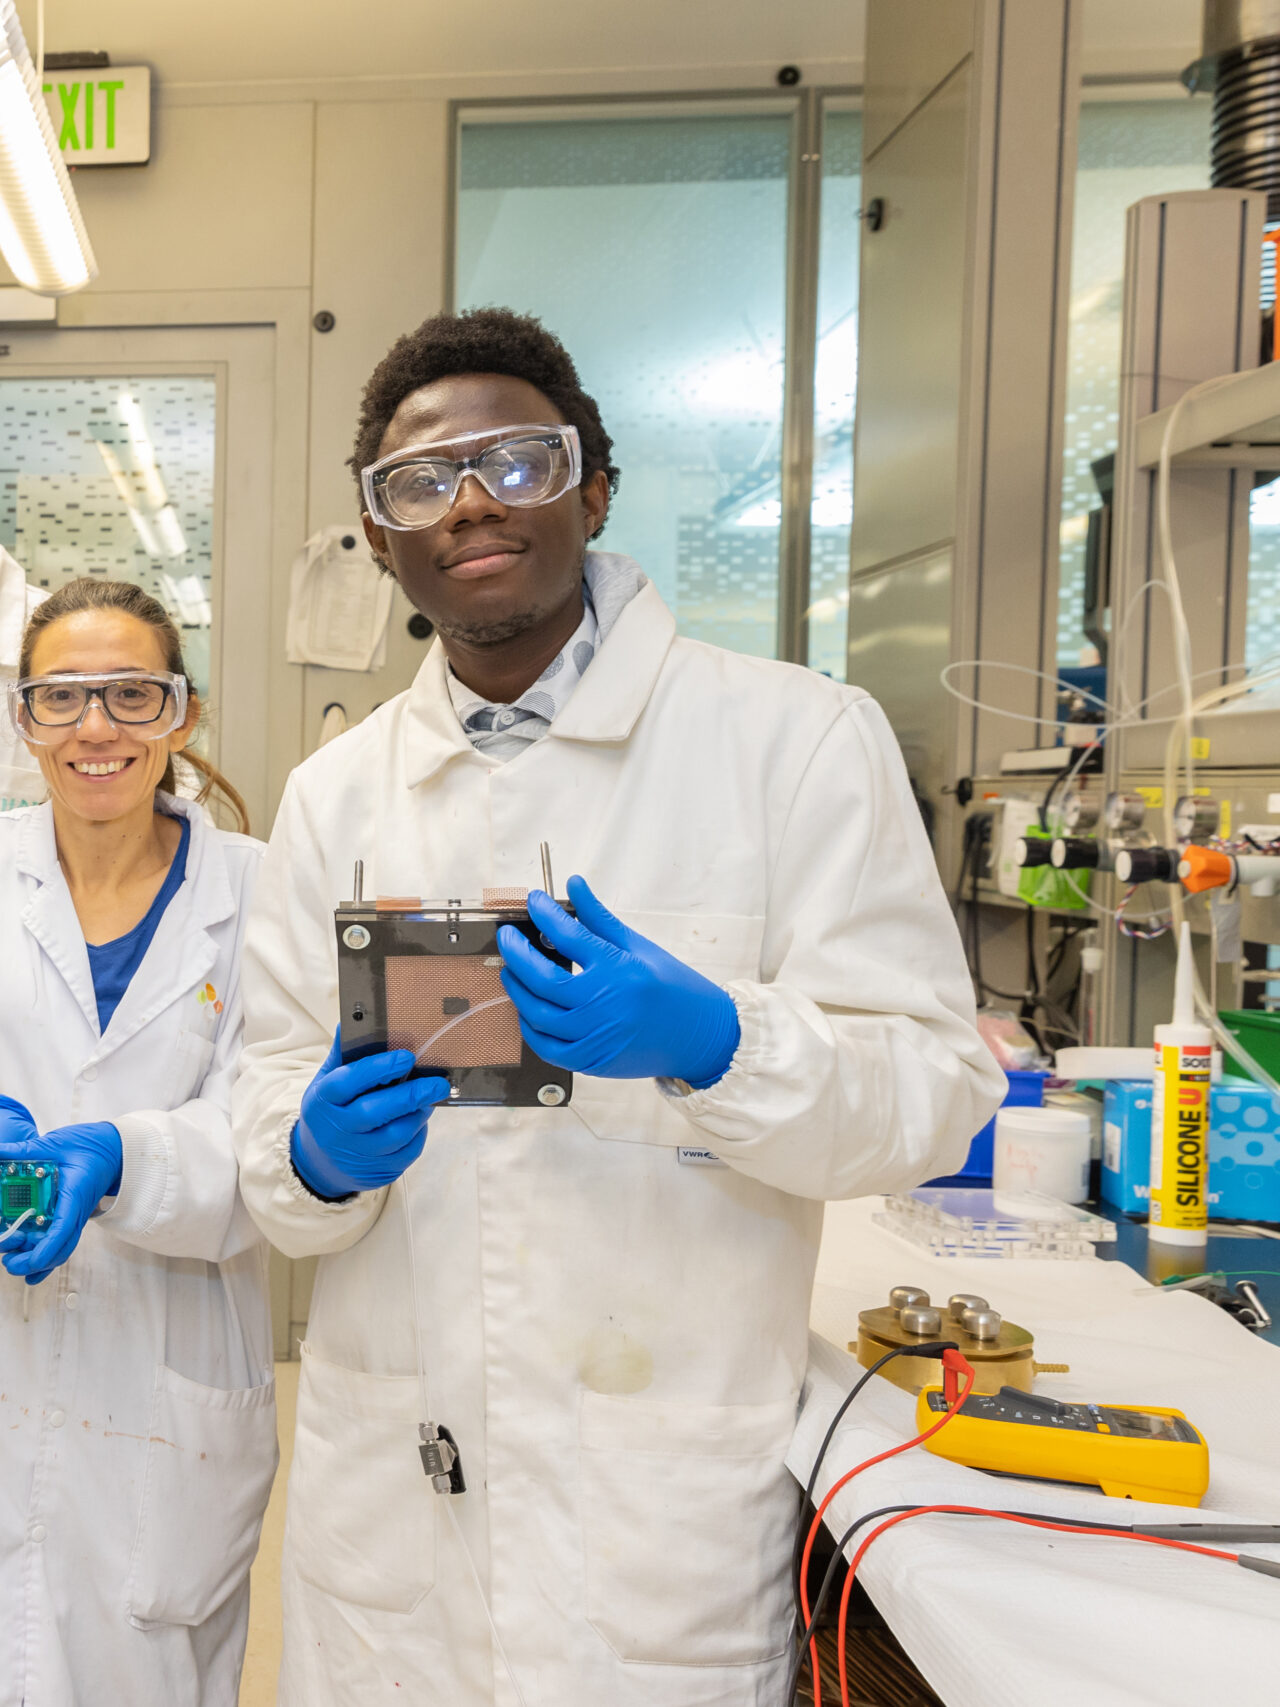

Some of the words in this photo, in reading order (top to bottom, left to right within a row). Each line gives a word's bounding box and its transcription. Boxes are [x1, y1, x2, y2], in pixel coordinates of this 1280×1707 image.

[42, 81, 124, 151] XIT
[1178, 1088, 1202, 1105] U
[1176, 1110, 1201, 1207] SILICONE
